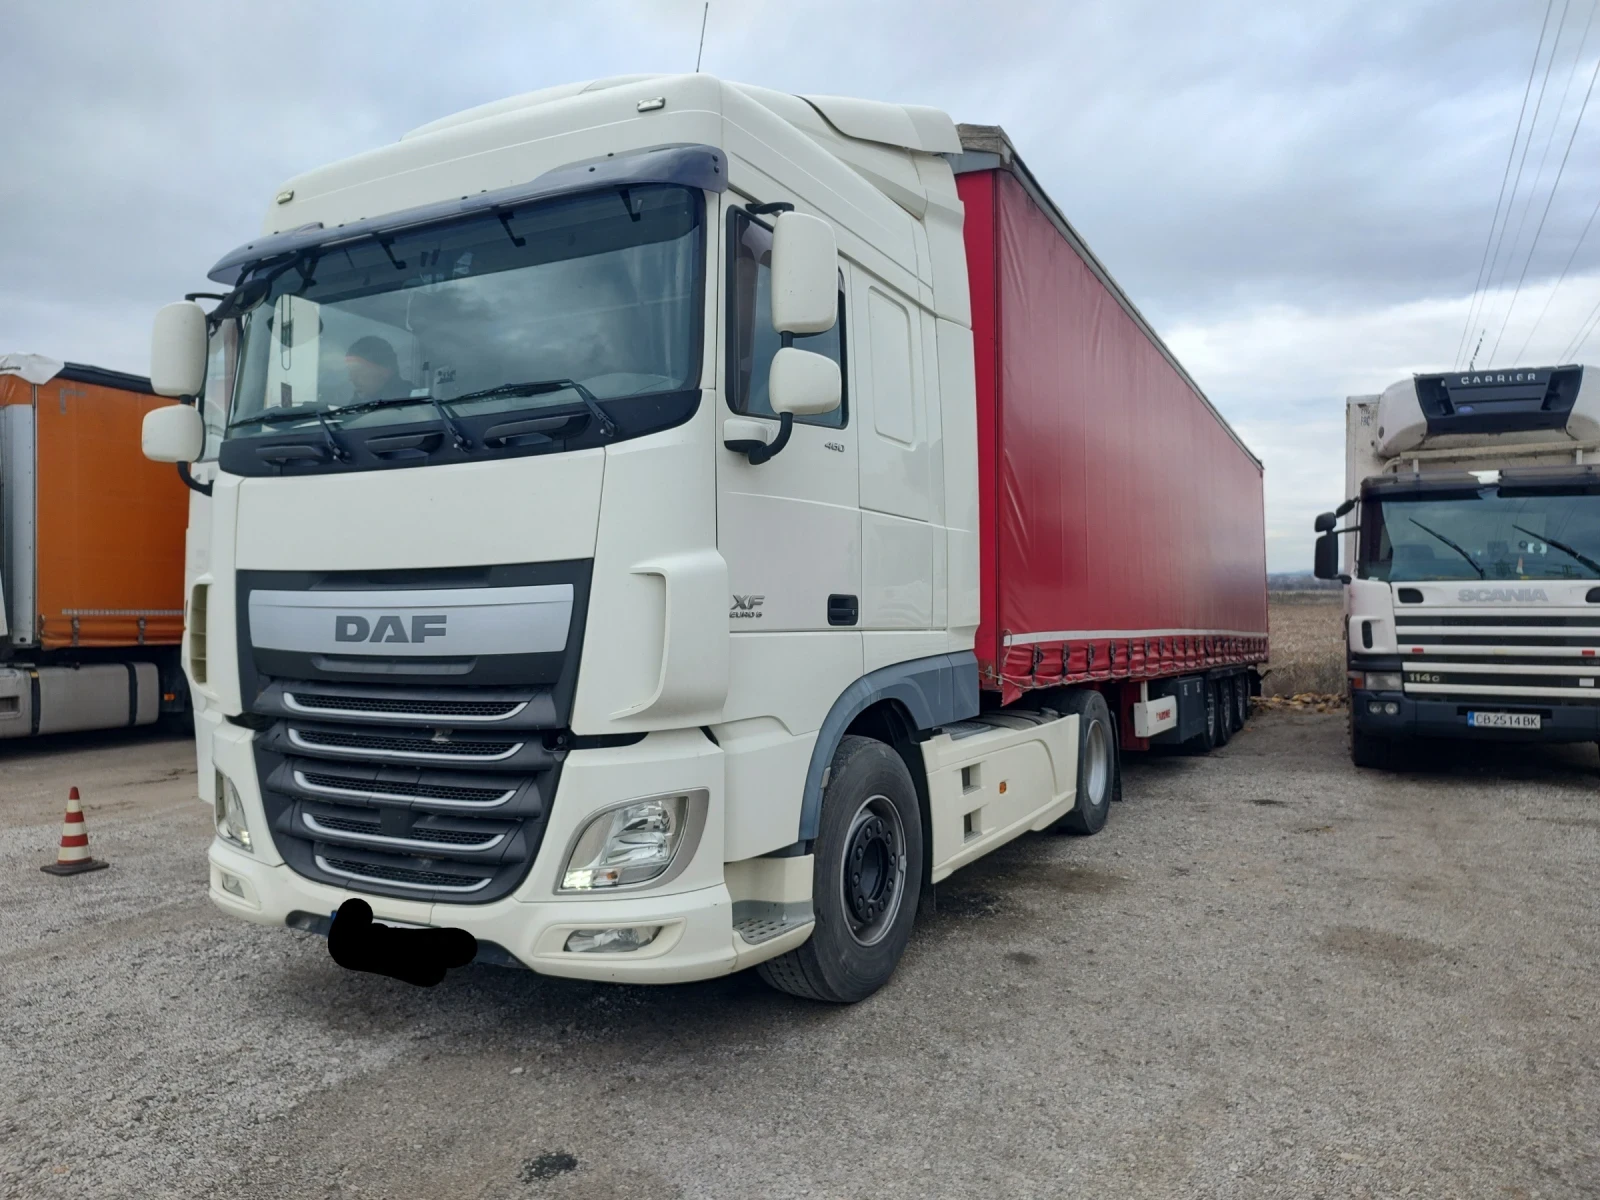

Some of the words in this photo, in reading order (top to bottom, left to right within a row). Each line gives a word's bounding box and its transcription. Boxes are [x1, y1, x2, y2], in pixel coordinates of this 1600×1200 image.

[1461, 373, 1536, 385] CARRIER
[824, 442, 845, 453] 460
[730, 594, 766, 610] XF
[1458, 588, 1549, 602] SCANIA
[335, 615, 447, 643] DAF
